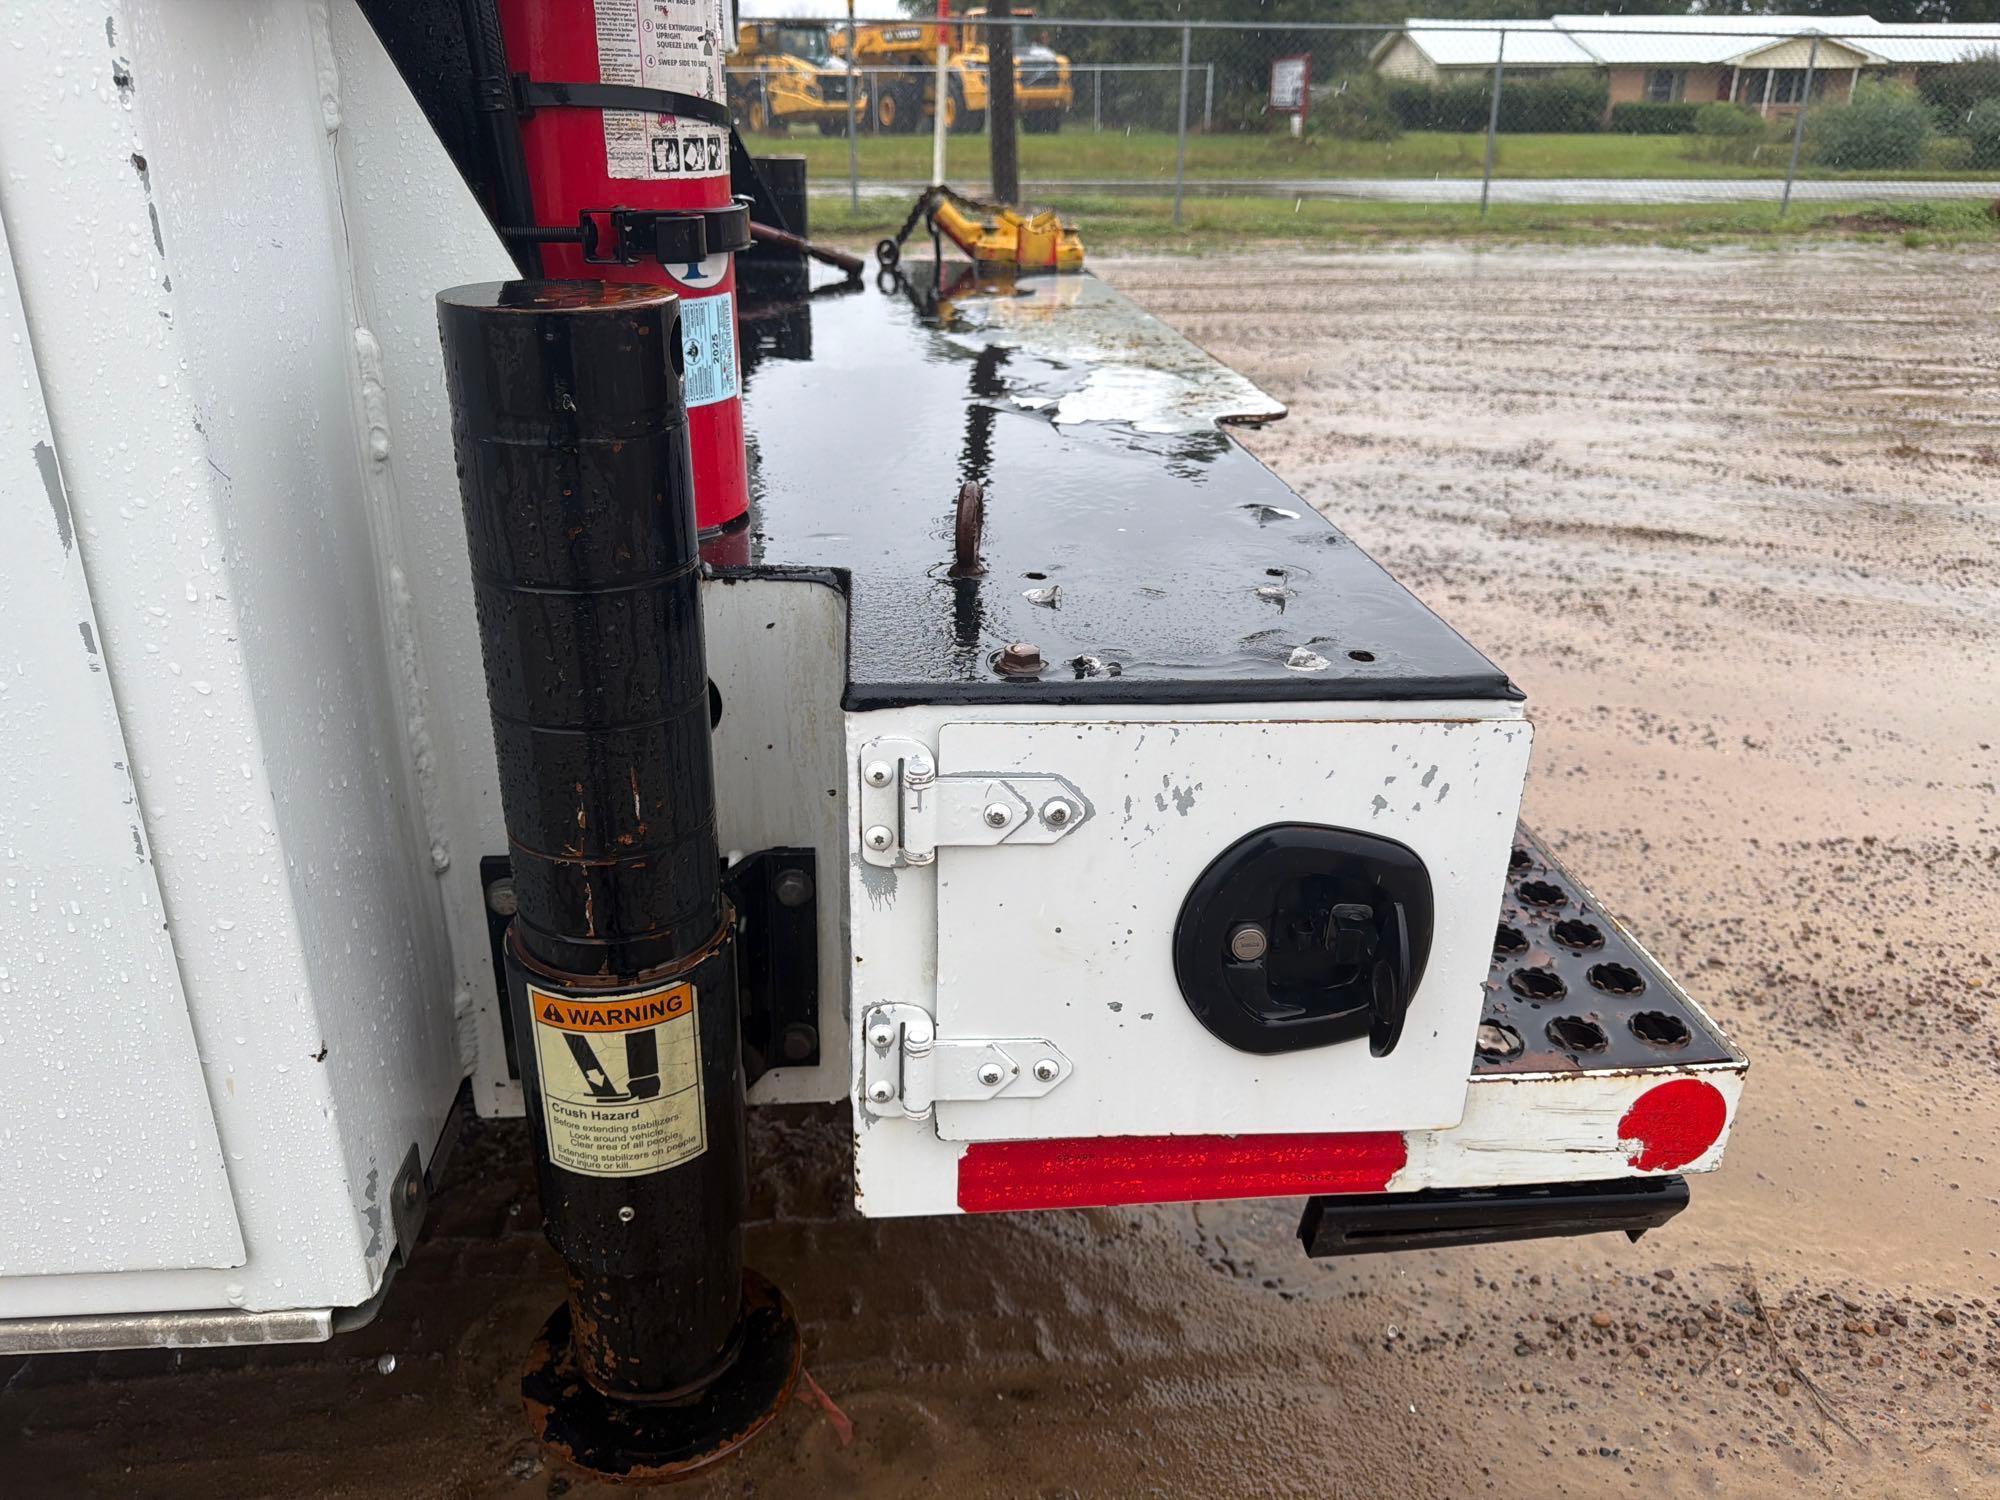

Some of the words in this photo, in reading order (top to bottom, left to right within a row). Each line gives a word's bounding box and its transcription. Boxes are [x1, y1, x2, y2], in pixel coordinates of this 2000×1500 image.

[655, 23, 667, 31] USE
[668, 24, 703, 32] EXTINGUISHER
[656, 41, 682, 49] SQUEEZE
[711, 333, 720, 365] 2025
[567, 995, 682, 1026] WARNING
[552, 1102, 587, 1119] Crush
[591, 1109, 639, 1121] Hazard
[554, 1116, 580, 1130] Before
[583, 1125, 629, 1134] extending
[569, 1130, 591, 1140] Look
[593, 1135, 627, 1143] around
[630, 1129, 667, 1141] vehicle.
[570, 1138, 594, 1149] Clear
[621, 1142, 630, 1150] of
[633, 1141, 644, 1149] all
[647, 1132, 682, 1147] people.
[557, 1144, 599, 1162] Extending
[601, 1152, 649, 1161] stabilizers
[666, 1135, 697, 1154] people
[558, 1153, 575, 1165] may
[577, 1160, 601, 1169] injure
